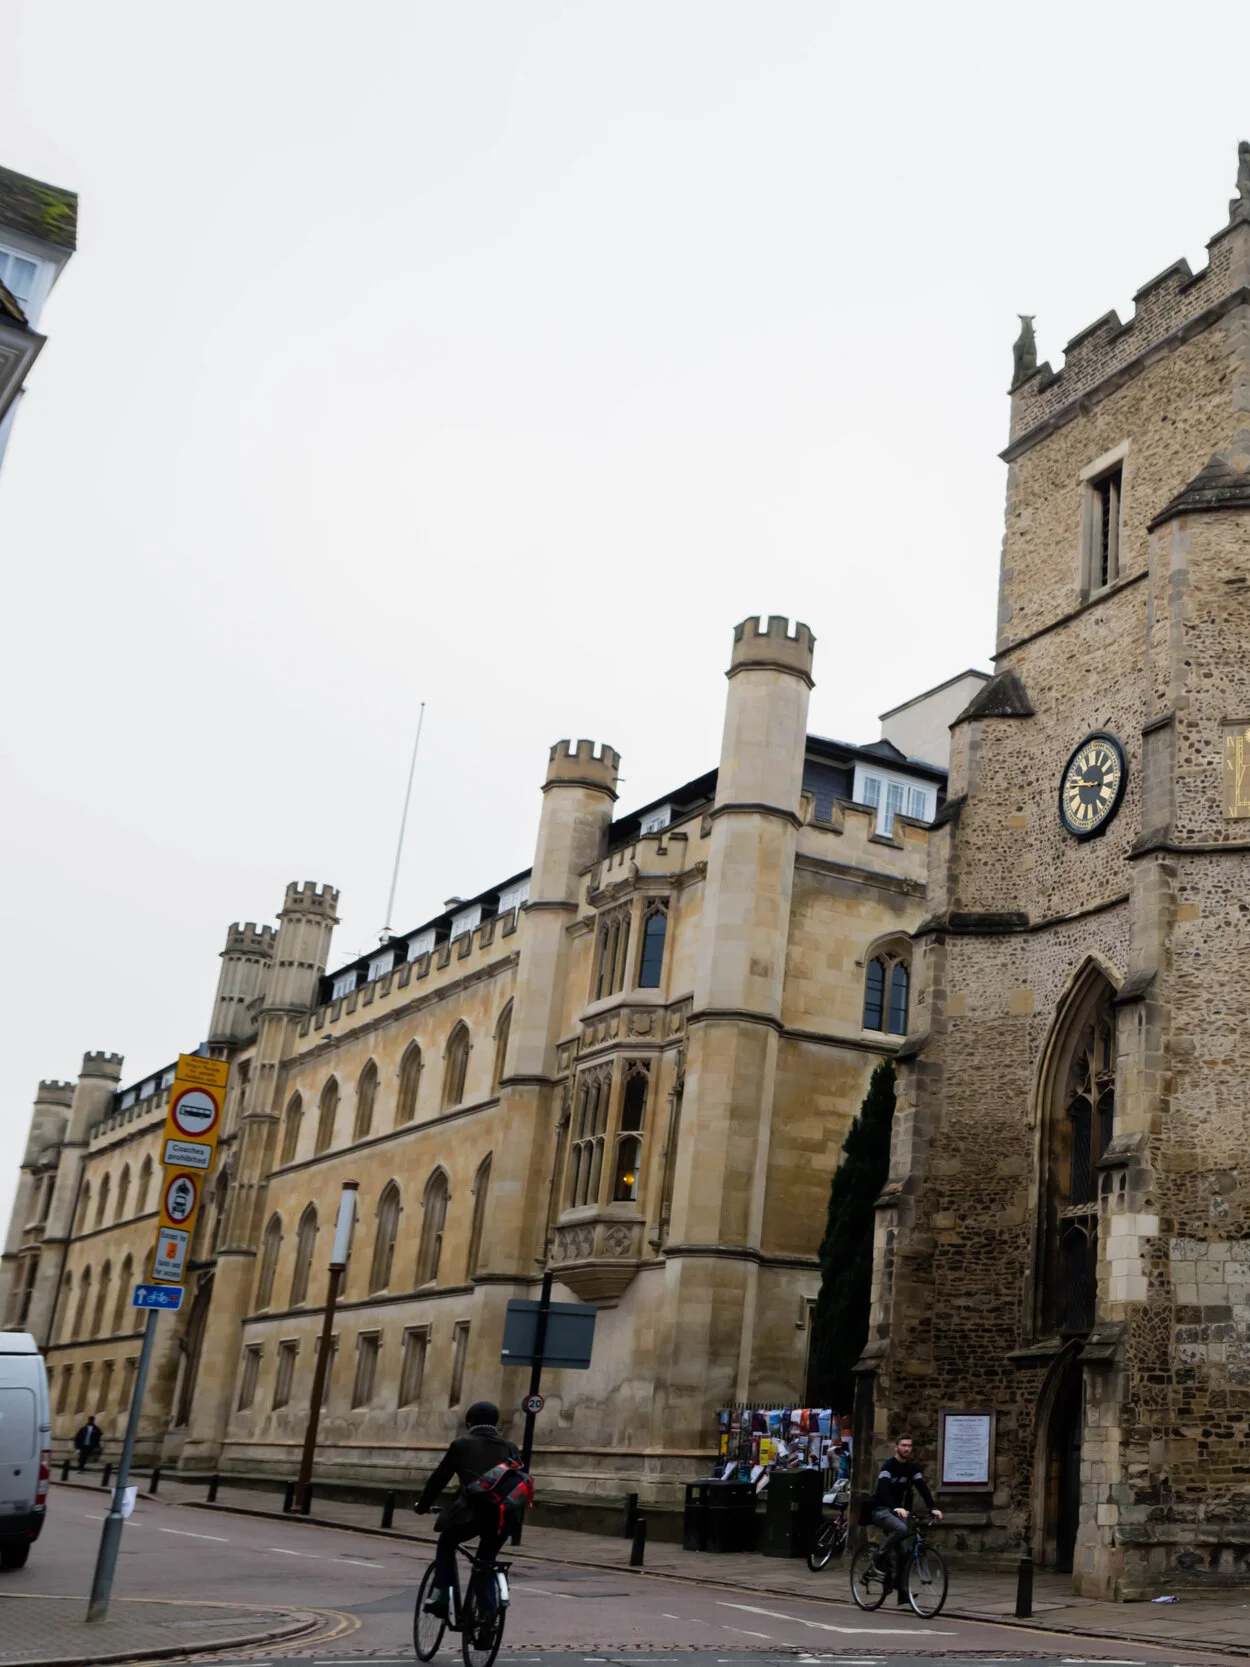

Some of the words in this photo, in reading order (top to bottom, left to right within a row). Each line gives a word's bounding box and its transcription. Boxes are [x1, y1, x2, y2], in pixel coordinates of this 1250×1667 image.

[173, 1144, 204, 1155] Coaches
[168, 1154, 207, 1165] prohibited
[529, 1400, 541, 1408] 20
